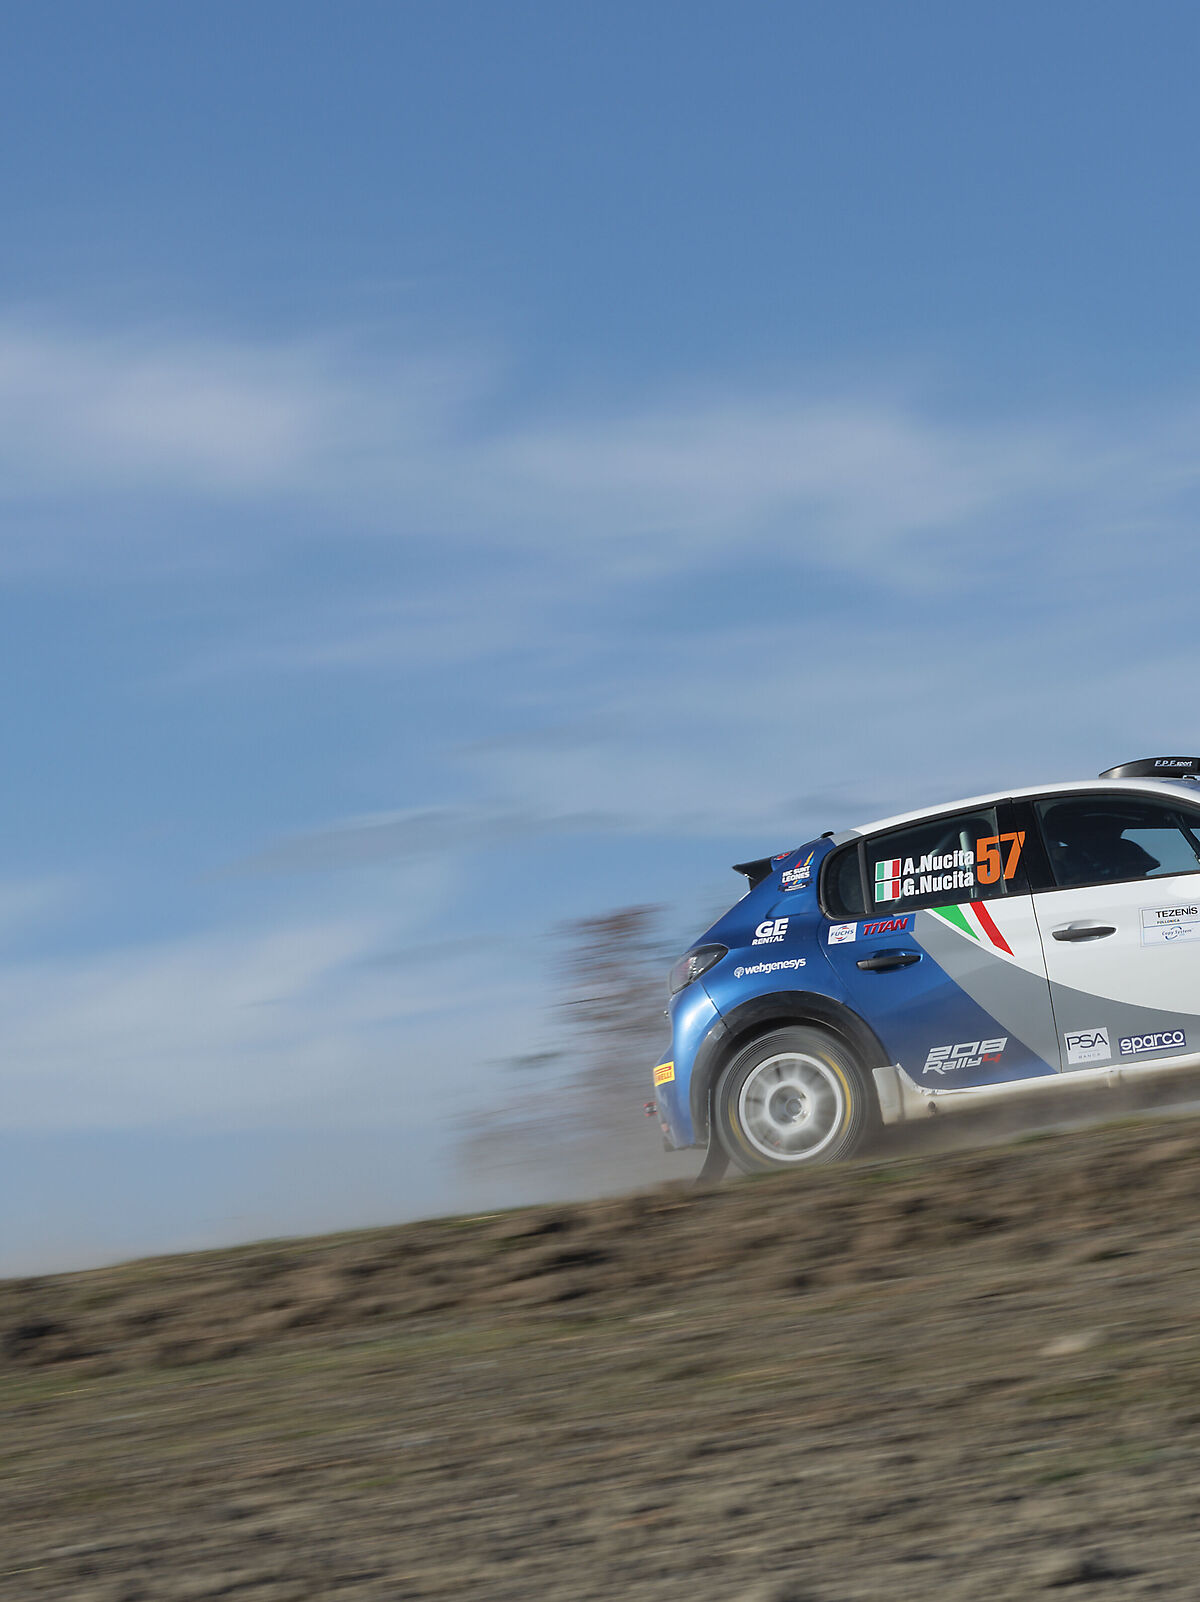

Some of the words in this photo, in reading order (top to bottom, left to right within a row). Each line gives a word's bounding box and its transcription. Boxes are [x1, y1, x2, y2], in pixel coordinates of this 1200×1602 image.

[903, 850, 974, 876] A.Nucita
[977, 831, 1025, 884] 57
[903, 870, 974, 896] G.Nucita
[755, 917, 789, 938] GE
[830, 929, 854, 937] FUCHS
[751, 935, 784, 946] RENTAL
[745, 958, 806, 974] webgenesys
[926, 1037, 1008, 1062] 208
[1067, 1033, 1108, 1051] PSA
[1120, 1031, 1184, 1053] sparco
